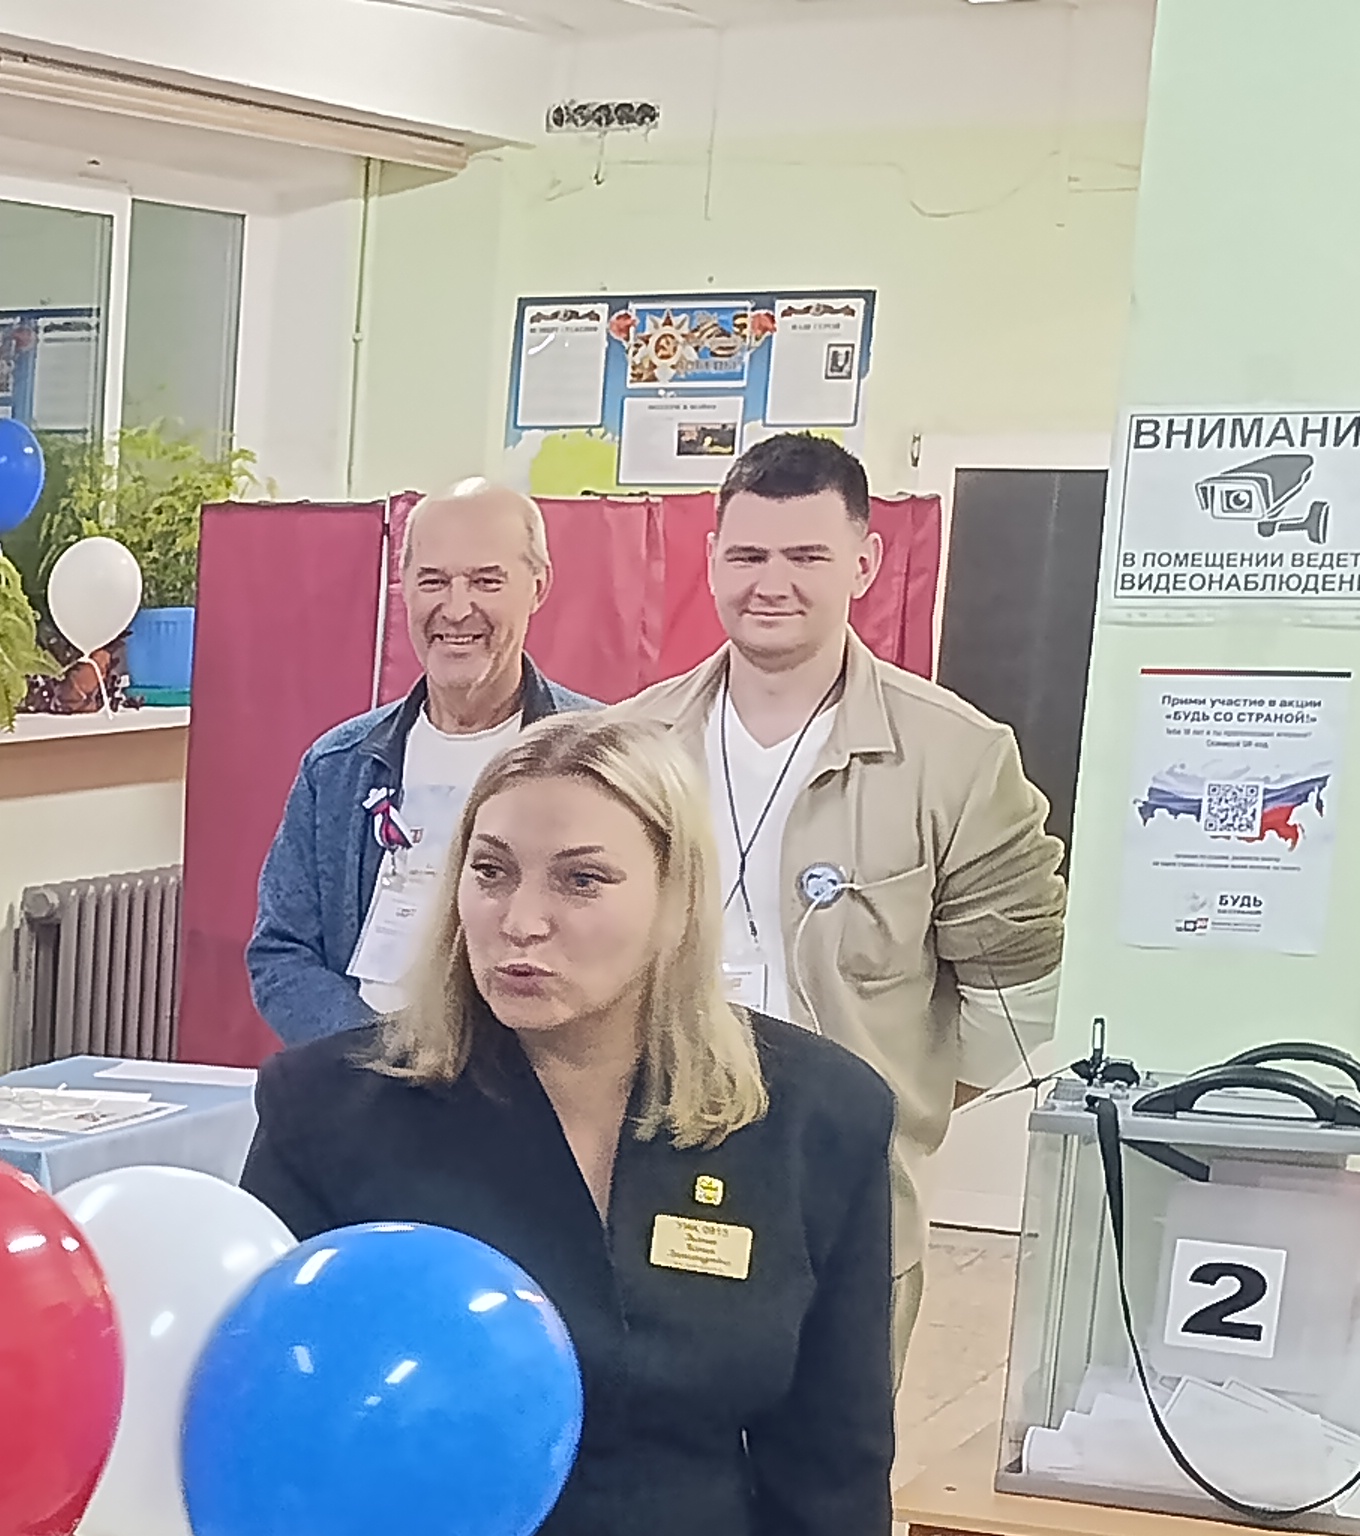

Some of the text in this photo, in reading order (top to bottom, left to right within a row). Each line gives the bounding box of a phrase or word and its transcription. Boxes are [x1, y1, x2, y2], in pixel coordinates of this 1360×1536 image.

[1122, 552, 1136, 568] В
[1142, 552, 1285, 570] ПОМЕЩЕНИИ
[1119, 572, 1360, 595] ВИДЕОНАБЛЮДЕН
[1161, 695, 1322, 709] Прими участие в акции
[1213, 711, 1234, 722] СО
[1218, 894, 1263, 908] БУДЬ
[1181, 1262, 1268, 1342] 2
